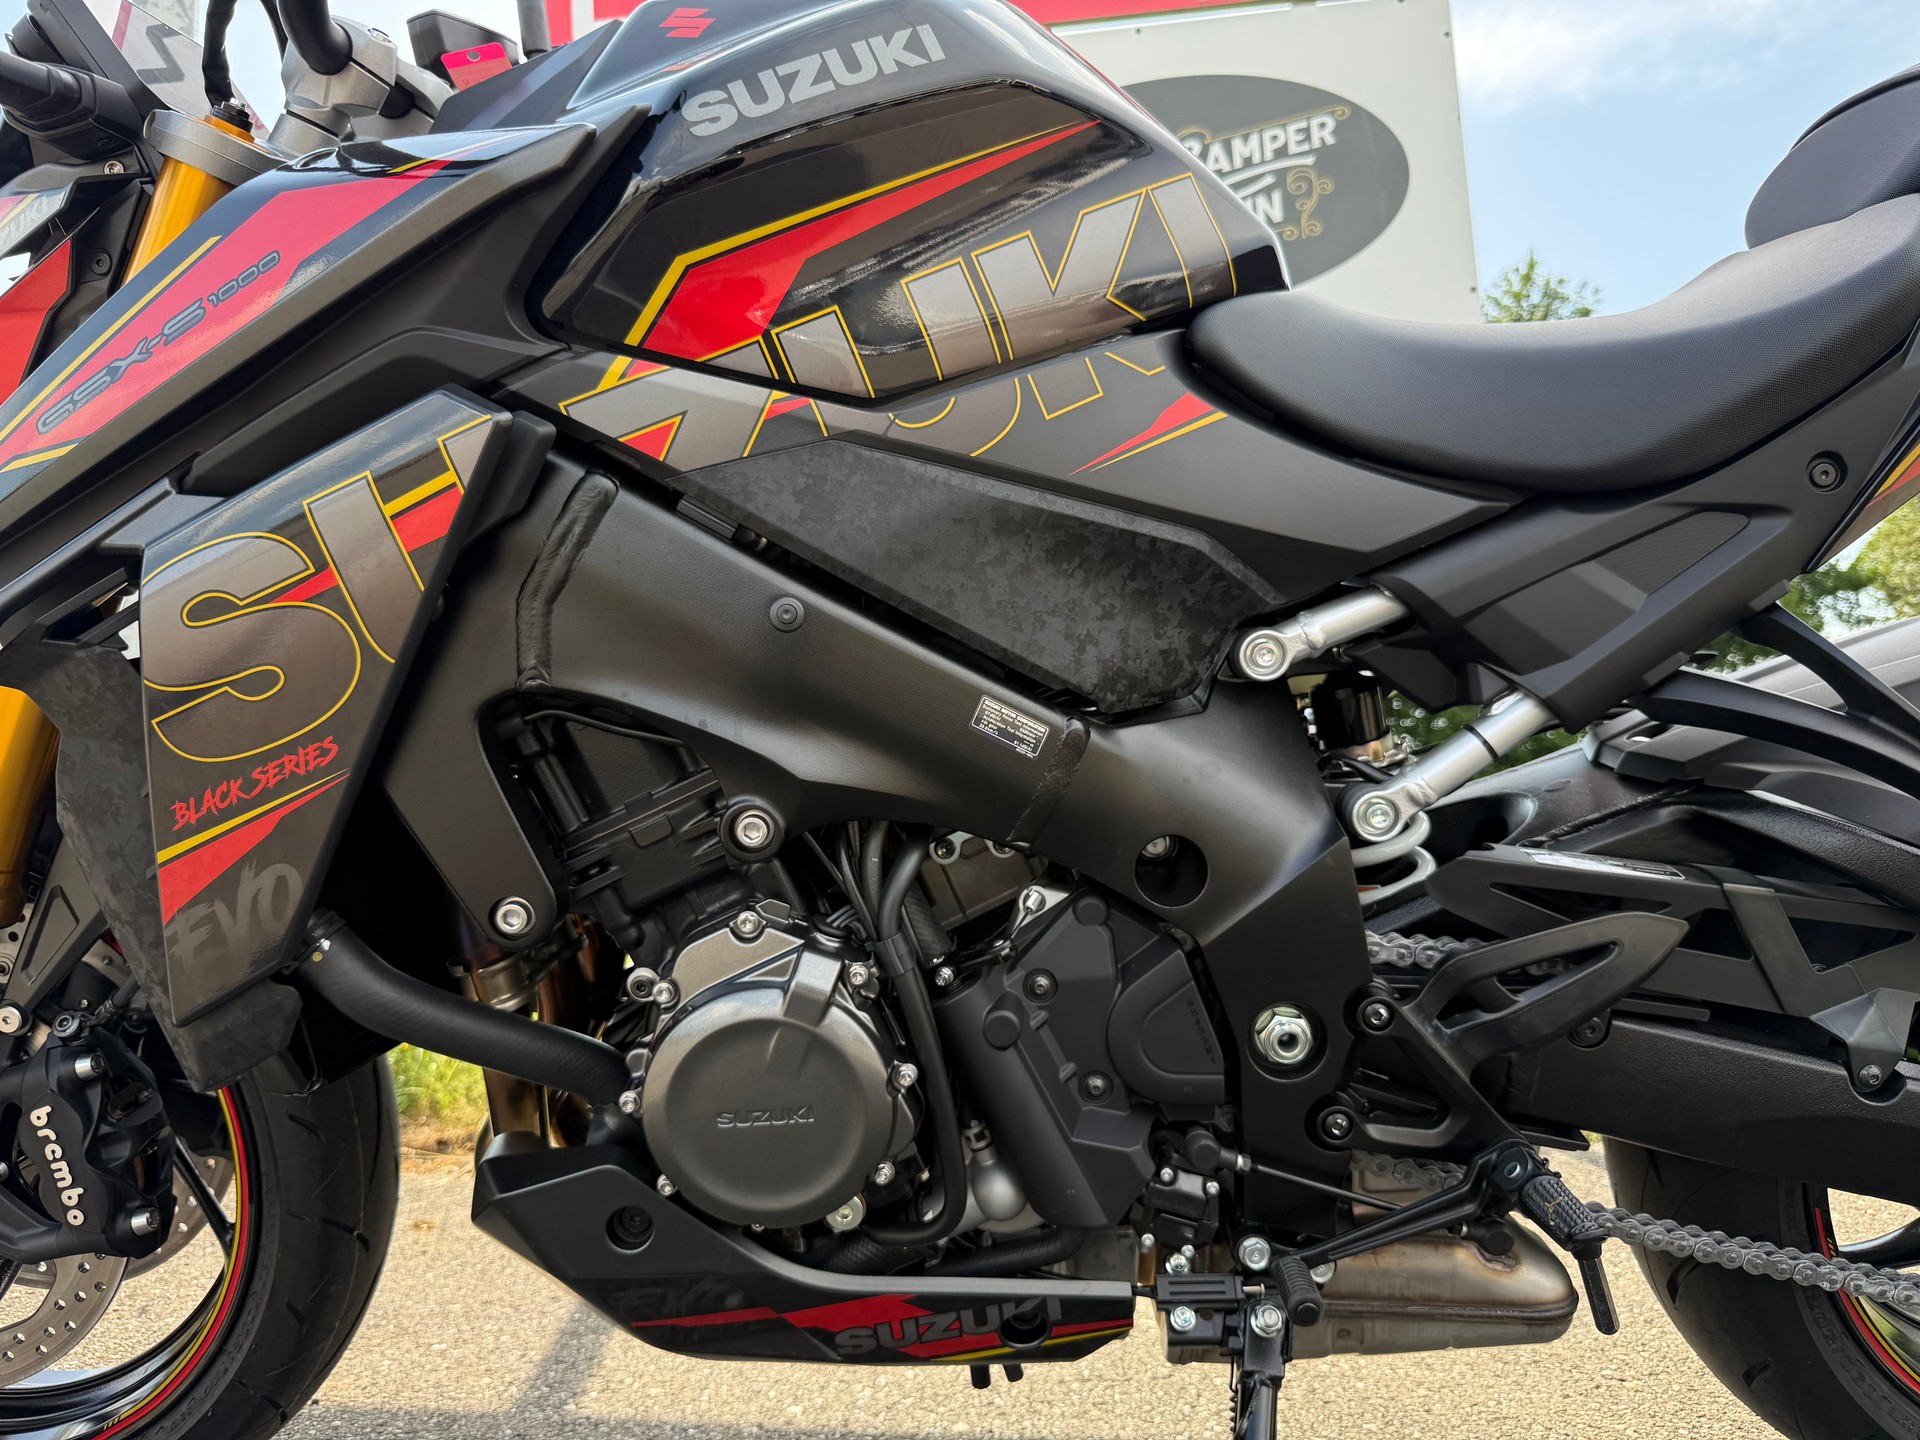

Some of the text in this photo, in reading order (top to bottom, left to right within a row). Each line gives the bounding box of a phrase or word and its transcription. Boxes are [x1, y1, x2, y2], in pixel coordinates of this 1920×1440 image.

[681, 23, 946, 137] SUZUKI
[169, 735, 340, 832] BLACK SERIES
[164, 858, 304, 975] EVO
[29, 1105, 85, 1226] brembo
[716, 1106, 815, 1127] SUZUKI
